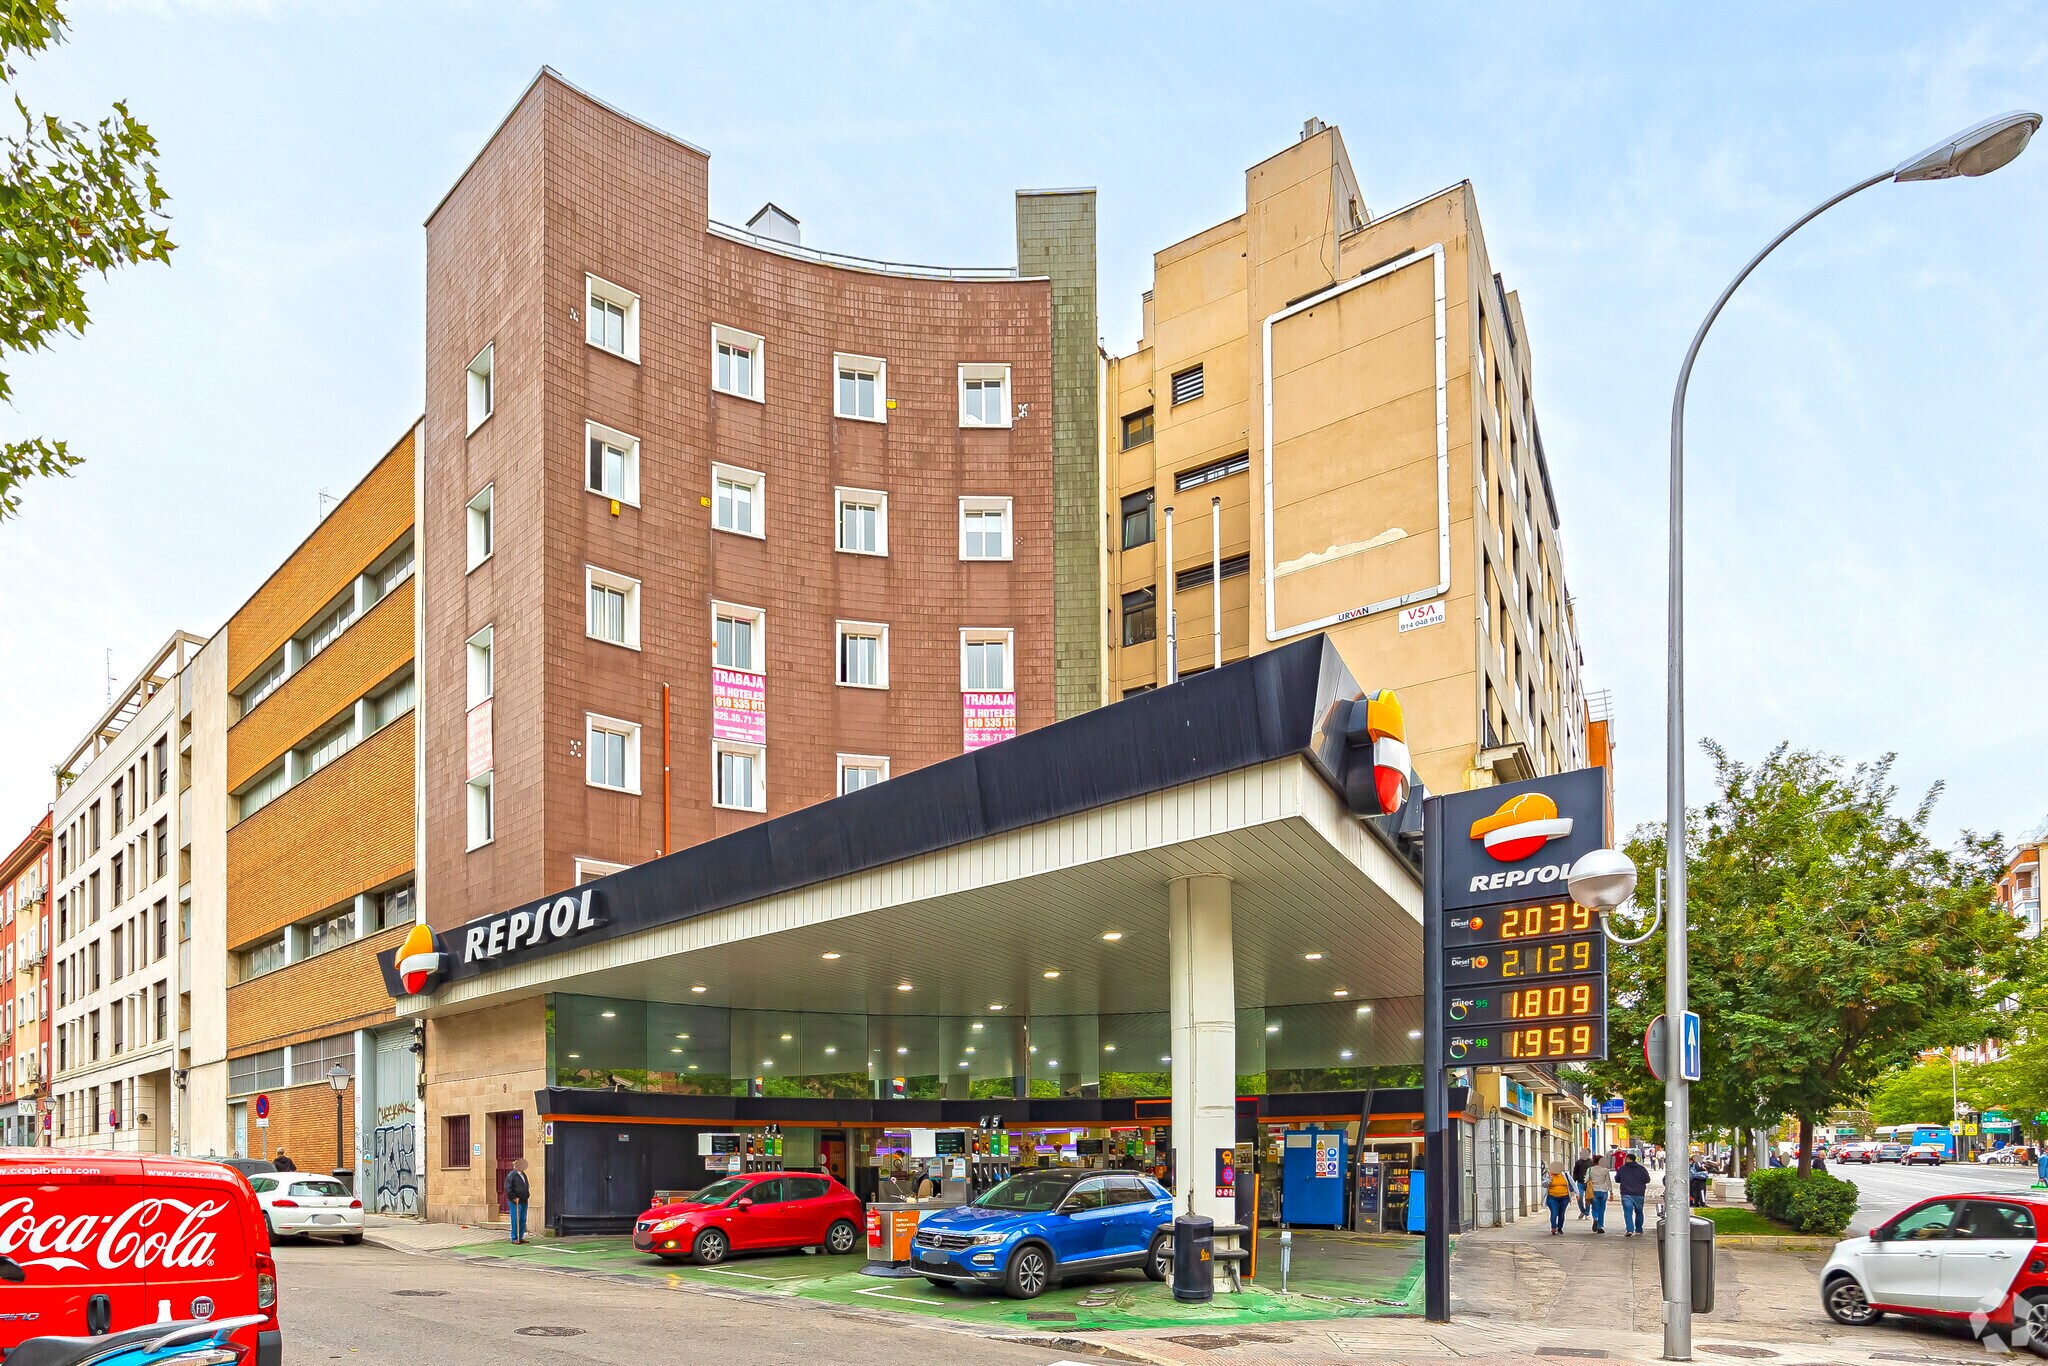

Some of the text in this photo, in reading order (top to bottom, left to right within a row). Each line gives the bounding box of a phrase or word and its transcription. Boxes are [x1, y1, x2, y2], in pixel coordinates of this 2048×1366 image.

[1338, 606, 1369, 622] URVAN
[1408, 604, 1435, 620] VSA
[1400, 614, 1443, 630] 914 048 910
[714, 670, 764, 688] TRABAJA
[714, 685, 764, 700] EN HOTELES
[964, 694, 1014, 706] TRABAJA
[716, 696, 732, 707] 910
[733, 698, 750, 709] 535
[751, 700, 765, 711] 011
[965, 709, 1015, 717] EN HOTELES
[967, 718, 1016, 727] 910 535 011
[1469, 863, 1572, 893] REPSOL
[464, 889, 596, 963] REPSOL
[1451, 919, 1469, 928] Diesel
[1502, 902, 1590, 938] 2.039
[1452, 958, 1470, 966] Diesel
[1502, 941, 1590, 977] 2.129
[1475, 1000, 1488, 1009] 95
[1510, 985, 1590, 1018] 1.809
[1475, 1038, 1488, 1047] 98
[1511, 1025, 1590, 1058] 1.959
[764, 1124, 777, 1134] 2 3
[980, 1118, 998, 1128] 4 5
[147, 1169, 232, 1180] www.cocacola.es
[0, 1197, 229, 1269] Coca-Cola
[196, 1303, 210, 1314] FIAT
